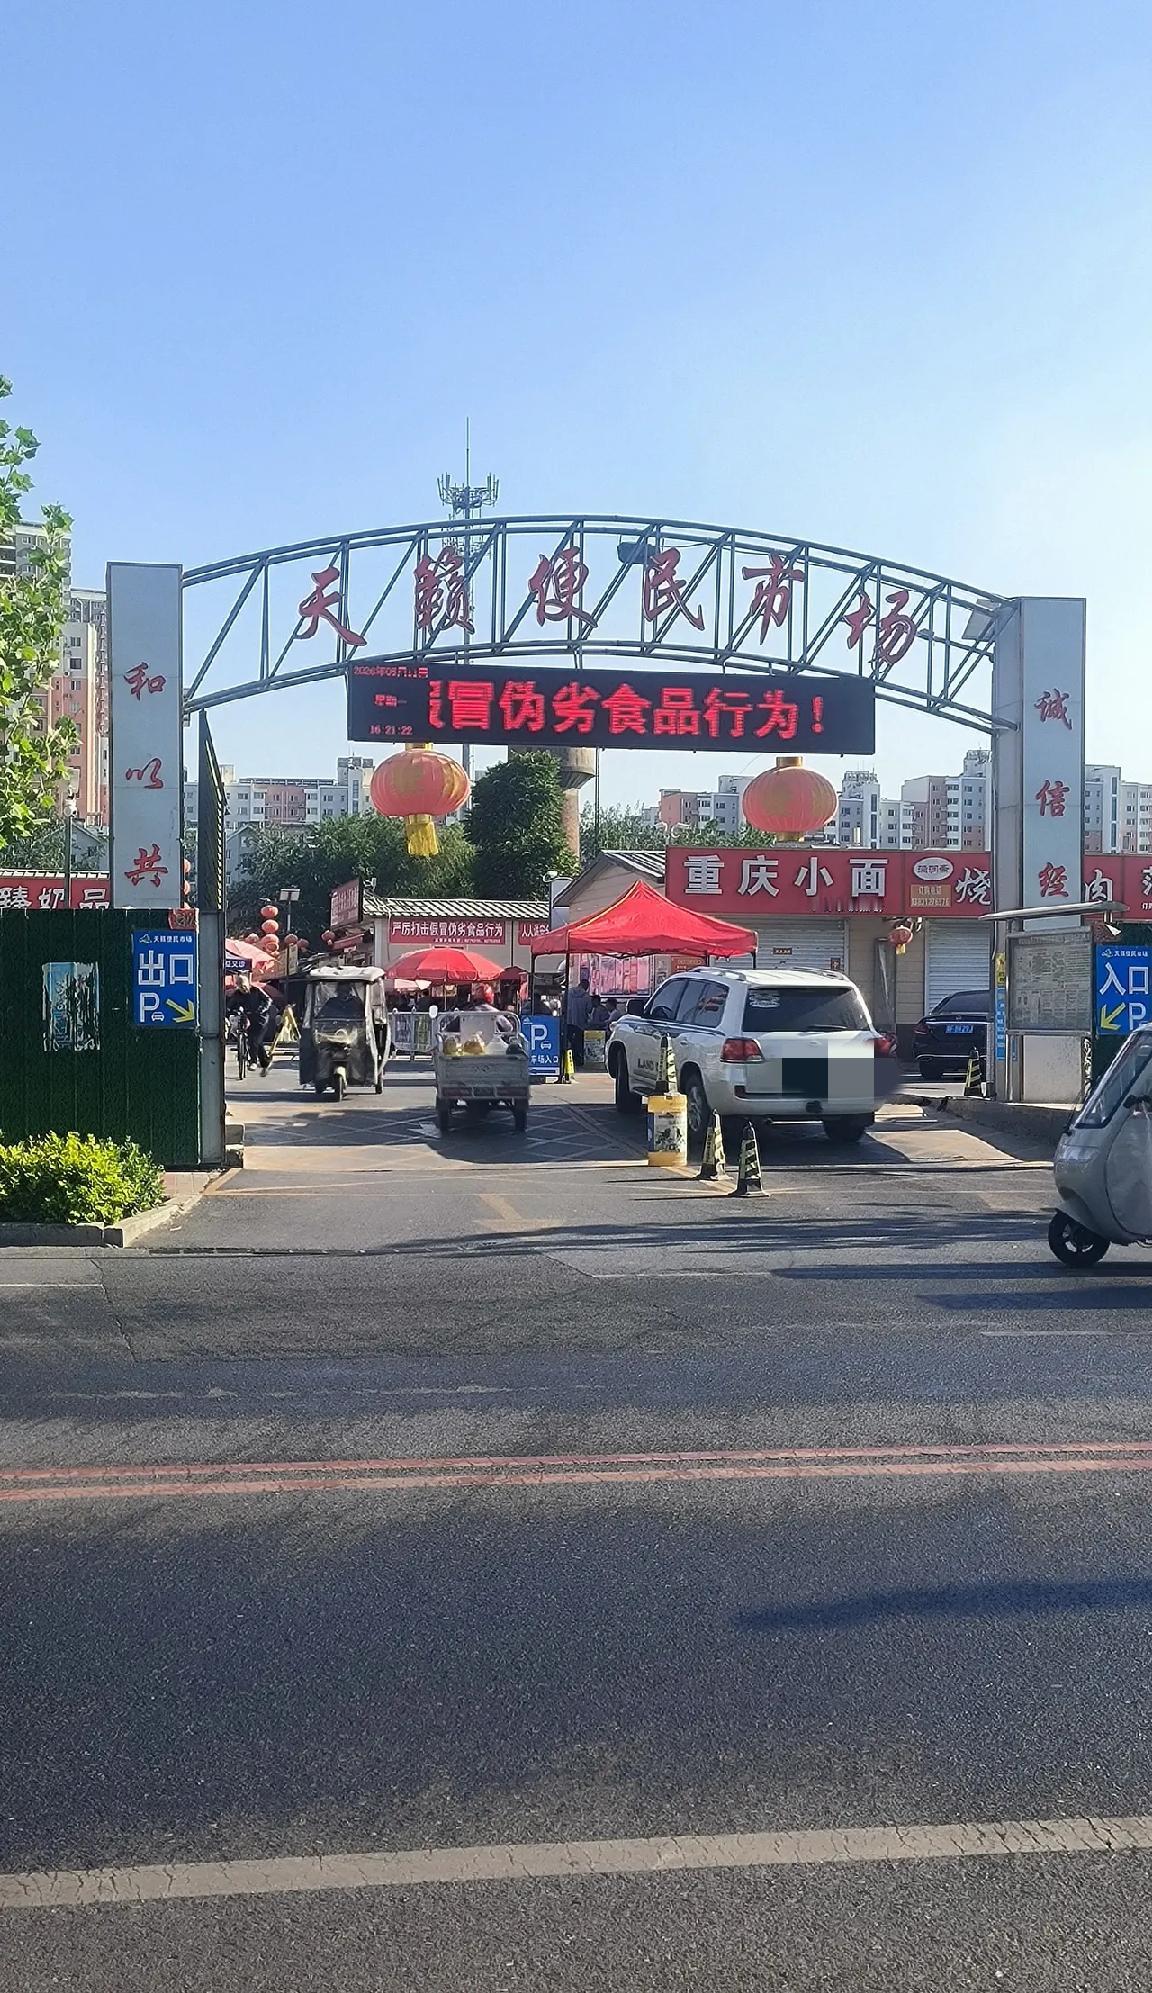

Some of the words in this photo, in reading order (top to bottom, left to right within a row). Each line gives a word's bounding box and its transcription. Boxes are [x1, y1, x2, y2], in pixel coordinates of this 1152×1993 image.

[374, 694, 408, 708] 星期一
[683, 854, 888, 898] 重庆小面
[392, 921, 503, 938] 严厉打击假冒伪劣食品行为
[138, 950, 194, 987] 出口
[1099, 962, 1149, 996] 入口
[139, 992, 160, 1022] P
[1128, 1002, 1147, 1031] P
[531, 1024, 548, 1050] P
